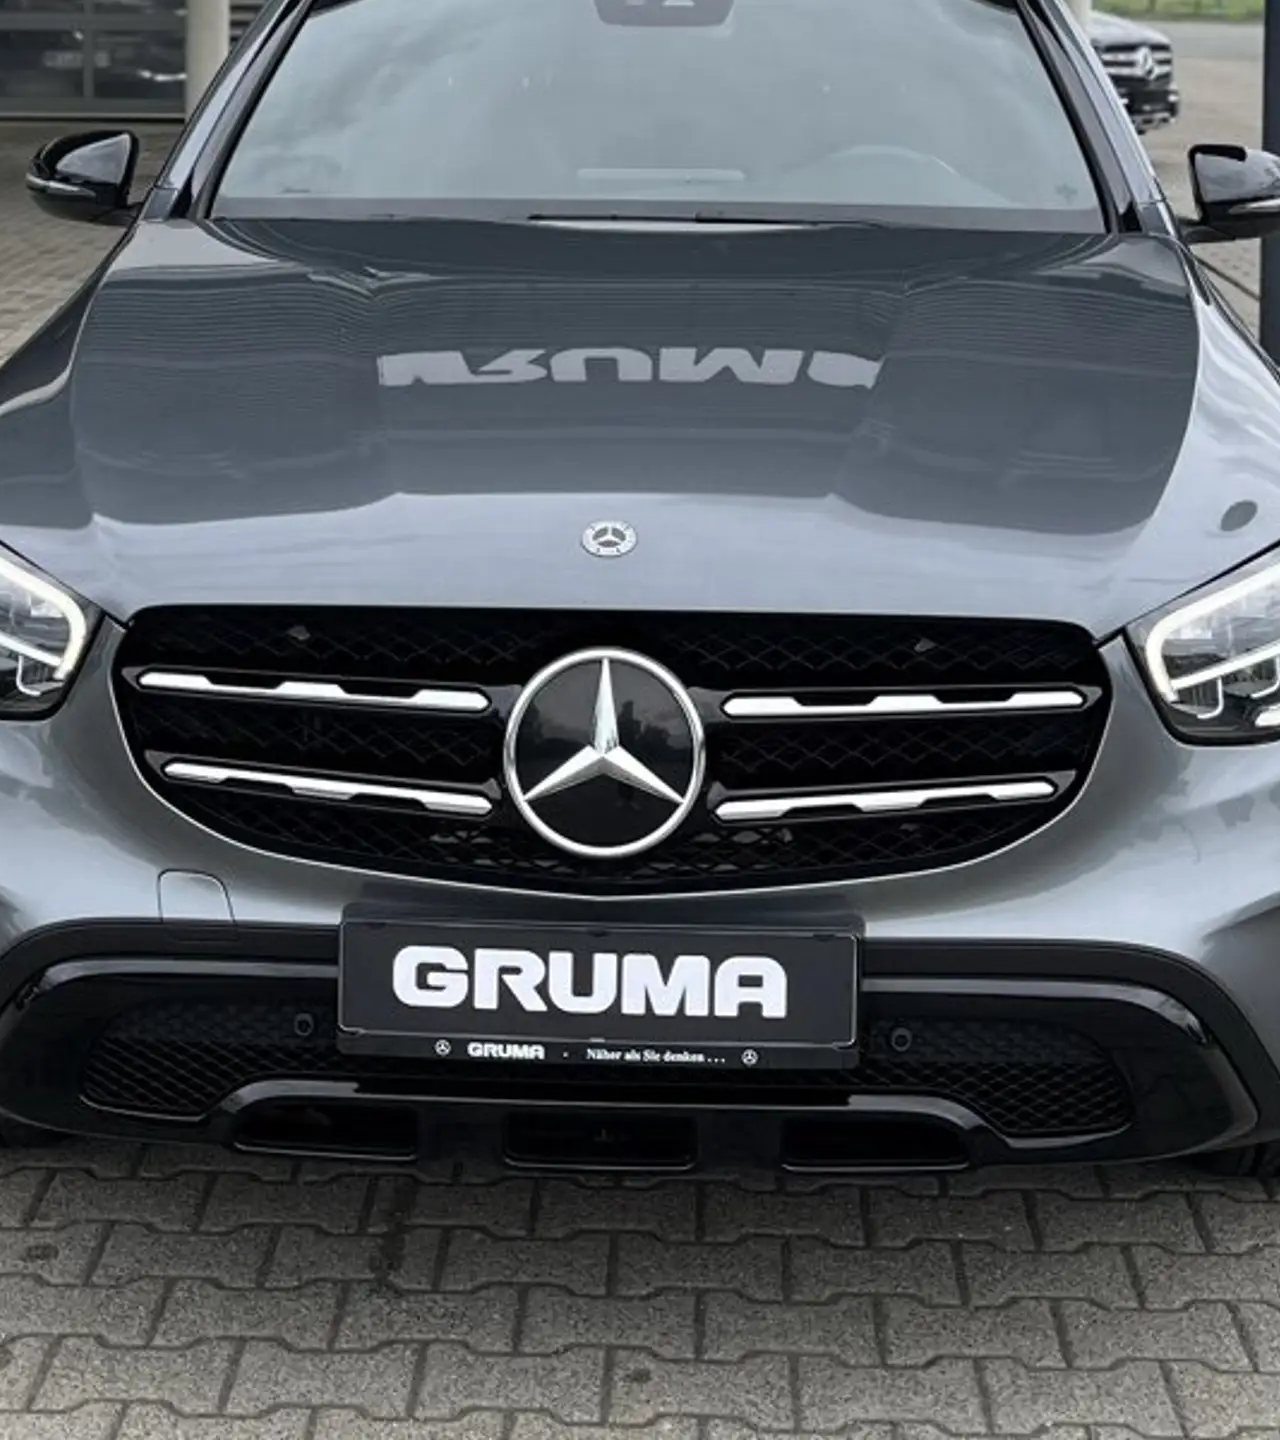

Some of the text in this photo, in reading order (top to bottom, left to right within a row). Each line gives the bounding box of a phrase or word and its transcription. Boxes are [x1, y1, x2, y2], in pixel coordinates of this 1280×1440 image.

[392, 945, 788, 1018] GRUMA
[467, 1041, 545, 1060] GRUMA
[642, 1049, 661, 1063] Sie
